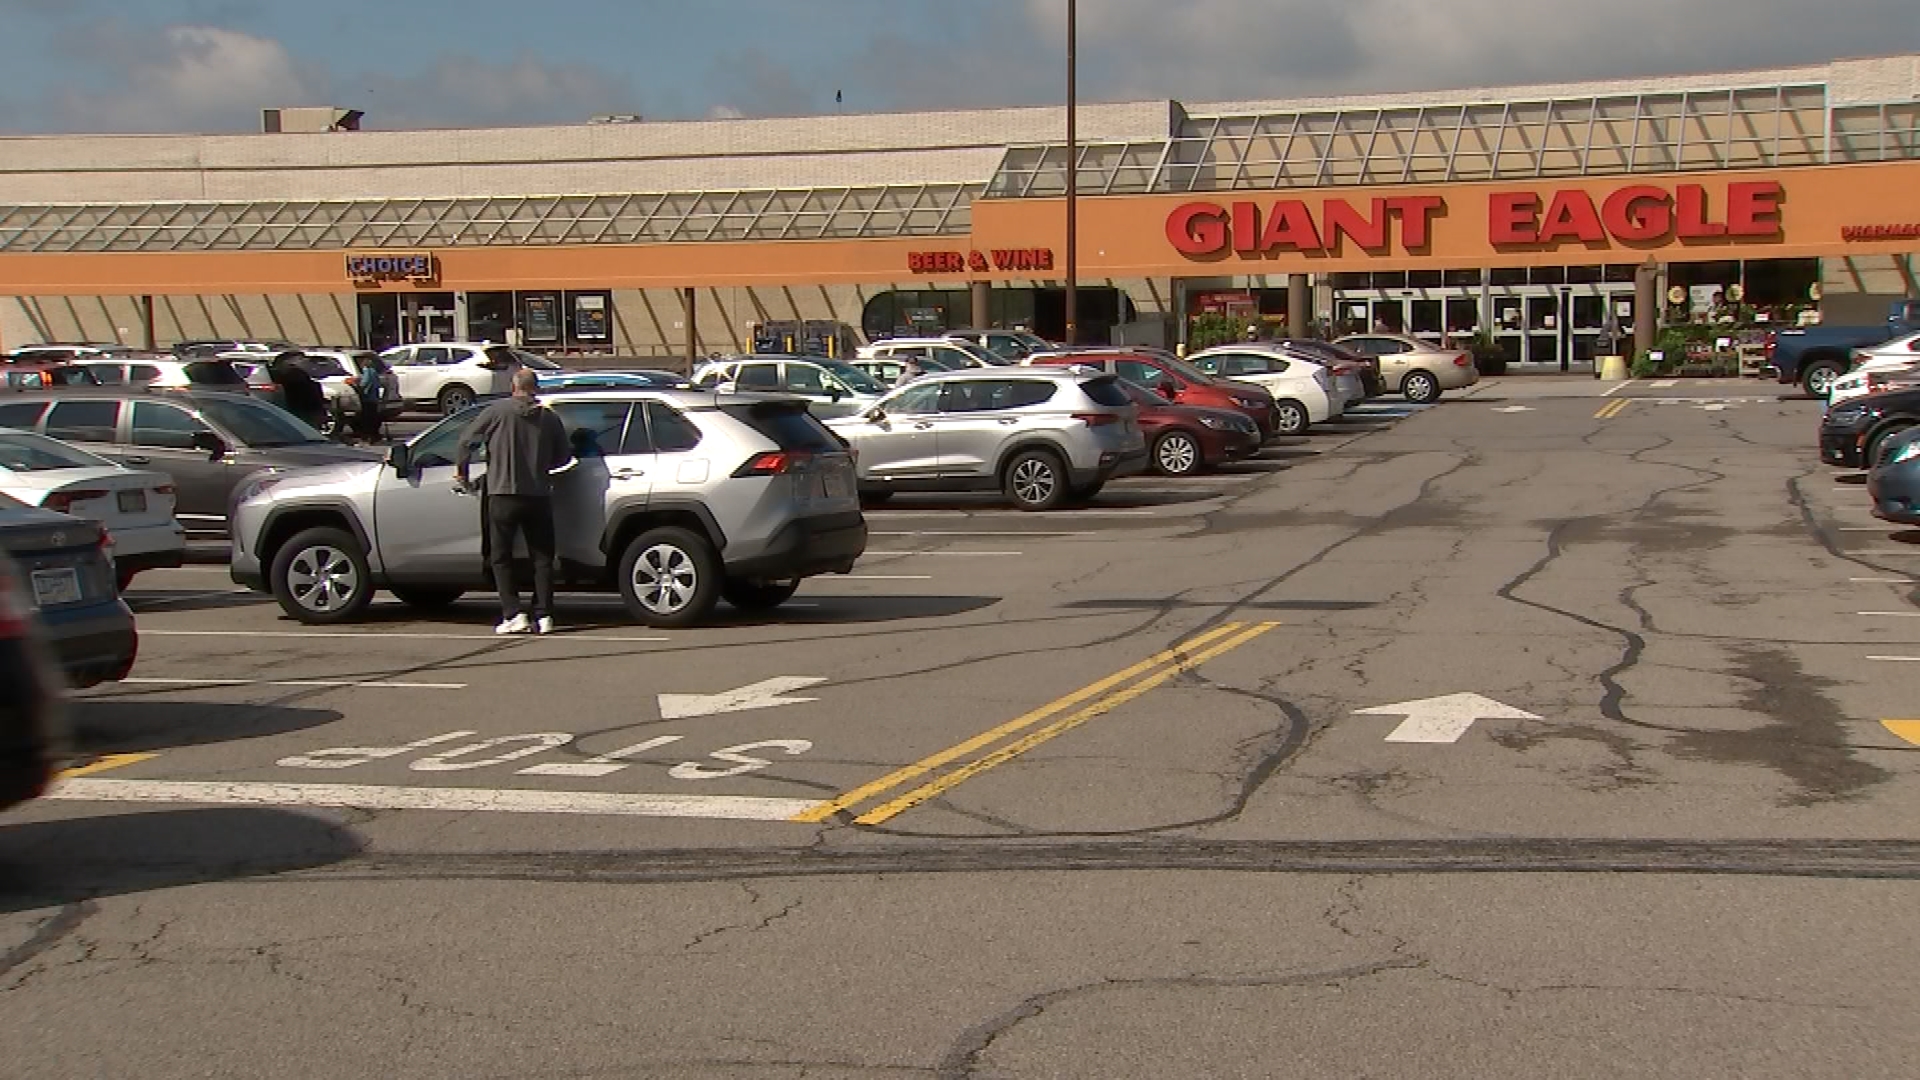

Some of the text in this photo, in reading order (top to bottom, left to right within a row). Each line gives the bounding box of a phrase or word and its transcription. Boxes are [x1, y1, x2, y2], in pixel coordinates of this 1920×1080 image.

[1165, 181, 1781, 256] GIANT EAGLE
[350, 256, 426, 273] CHOICE
[908, 248, 1052, 271] BEER & WINE
[274, 729, 813, 779] STOP
